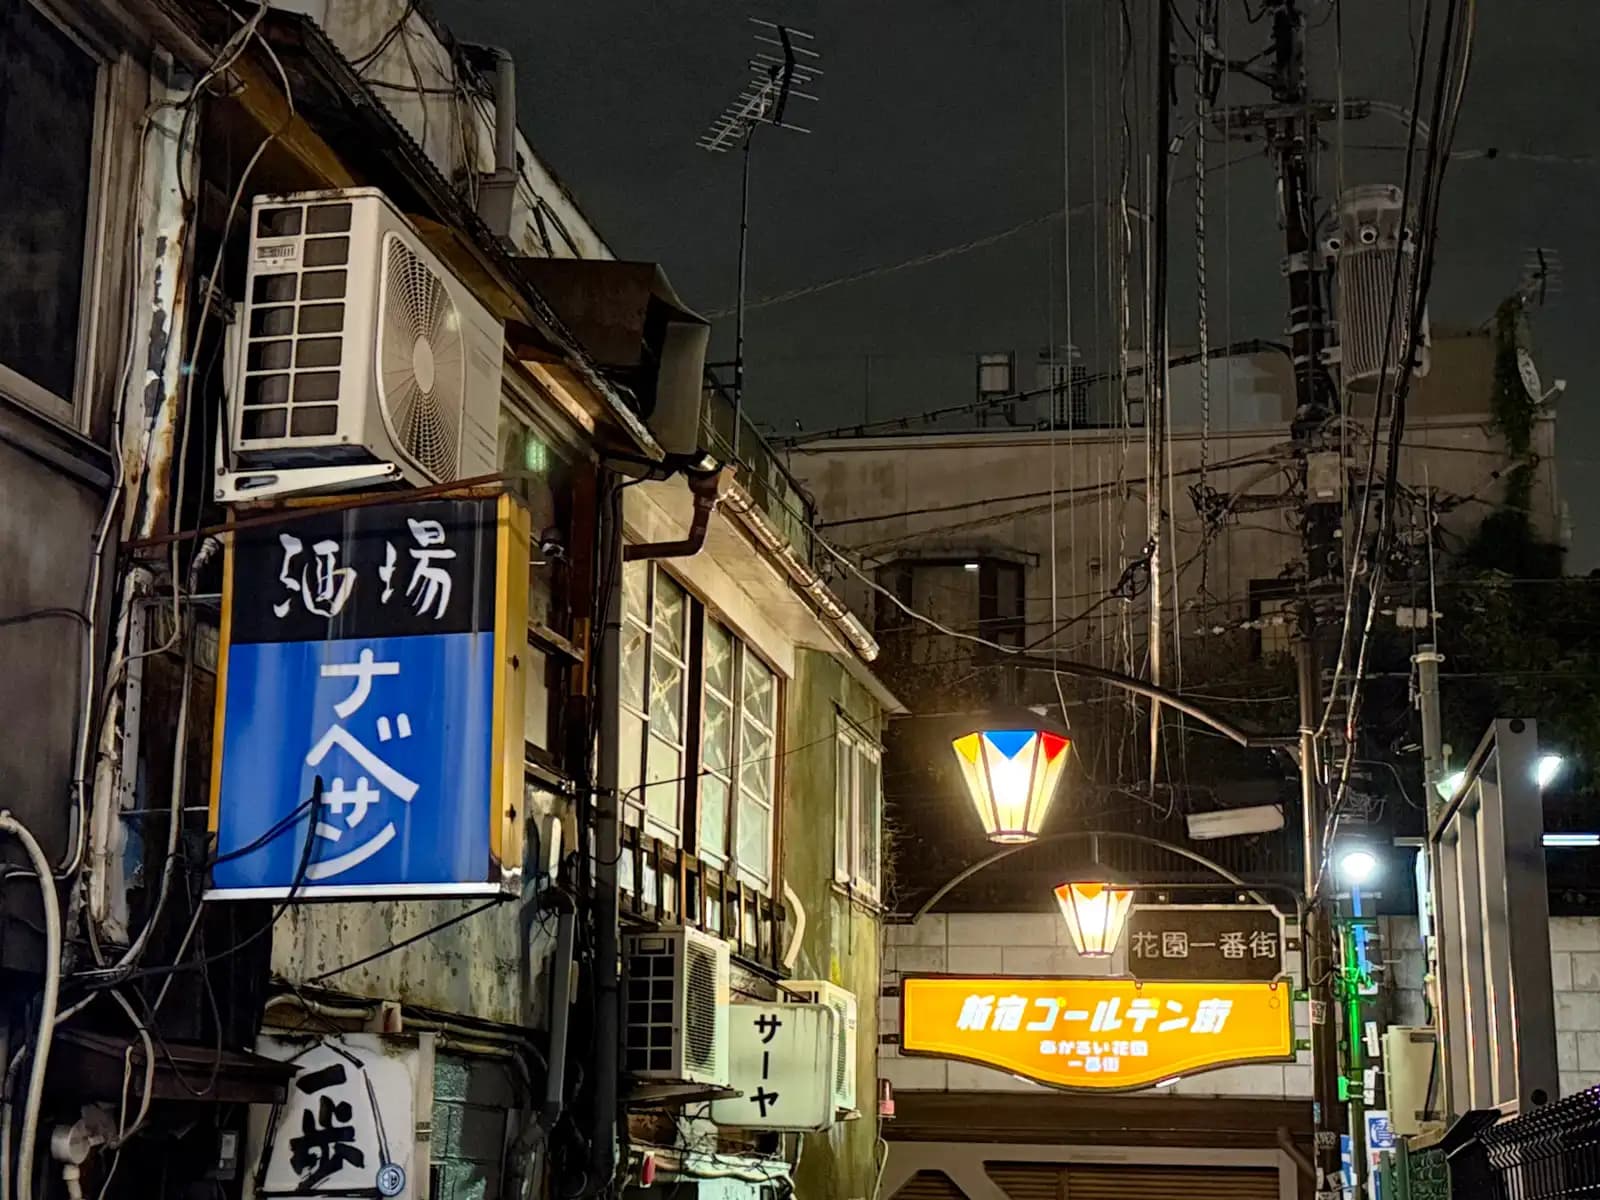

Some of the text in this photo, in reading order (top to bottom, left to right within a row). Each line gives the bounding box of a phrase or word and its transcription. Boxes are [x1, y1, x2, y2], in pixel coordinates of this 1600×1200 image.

[273, 518, 457, 620] 酒場
[305, 648, 420, 880] ナベサン
[1132, 931, 1278, 959] 花園一番街
[956, 994, 1234, 1034] 新宿ゴールデン街
[750, 1014, 783, 1118] サーヤ
[289, 1063, 366, 1192] 一歩
